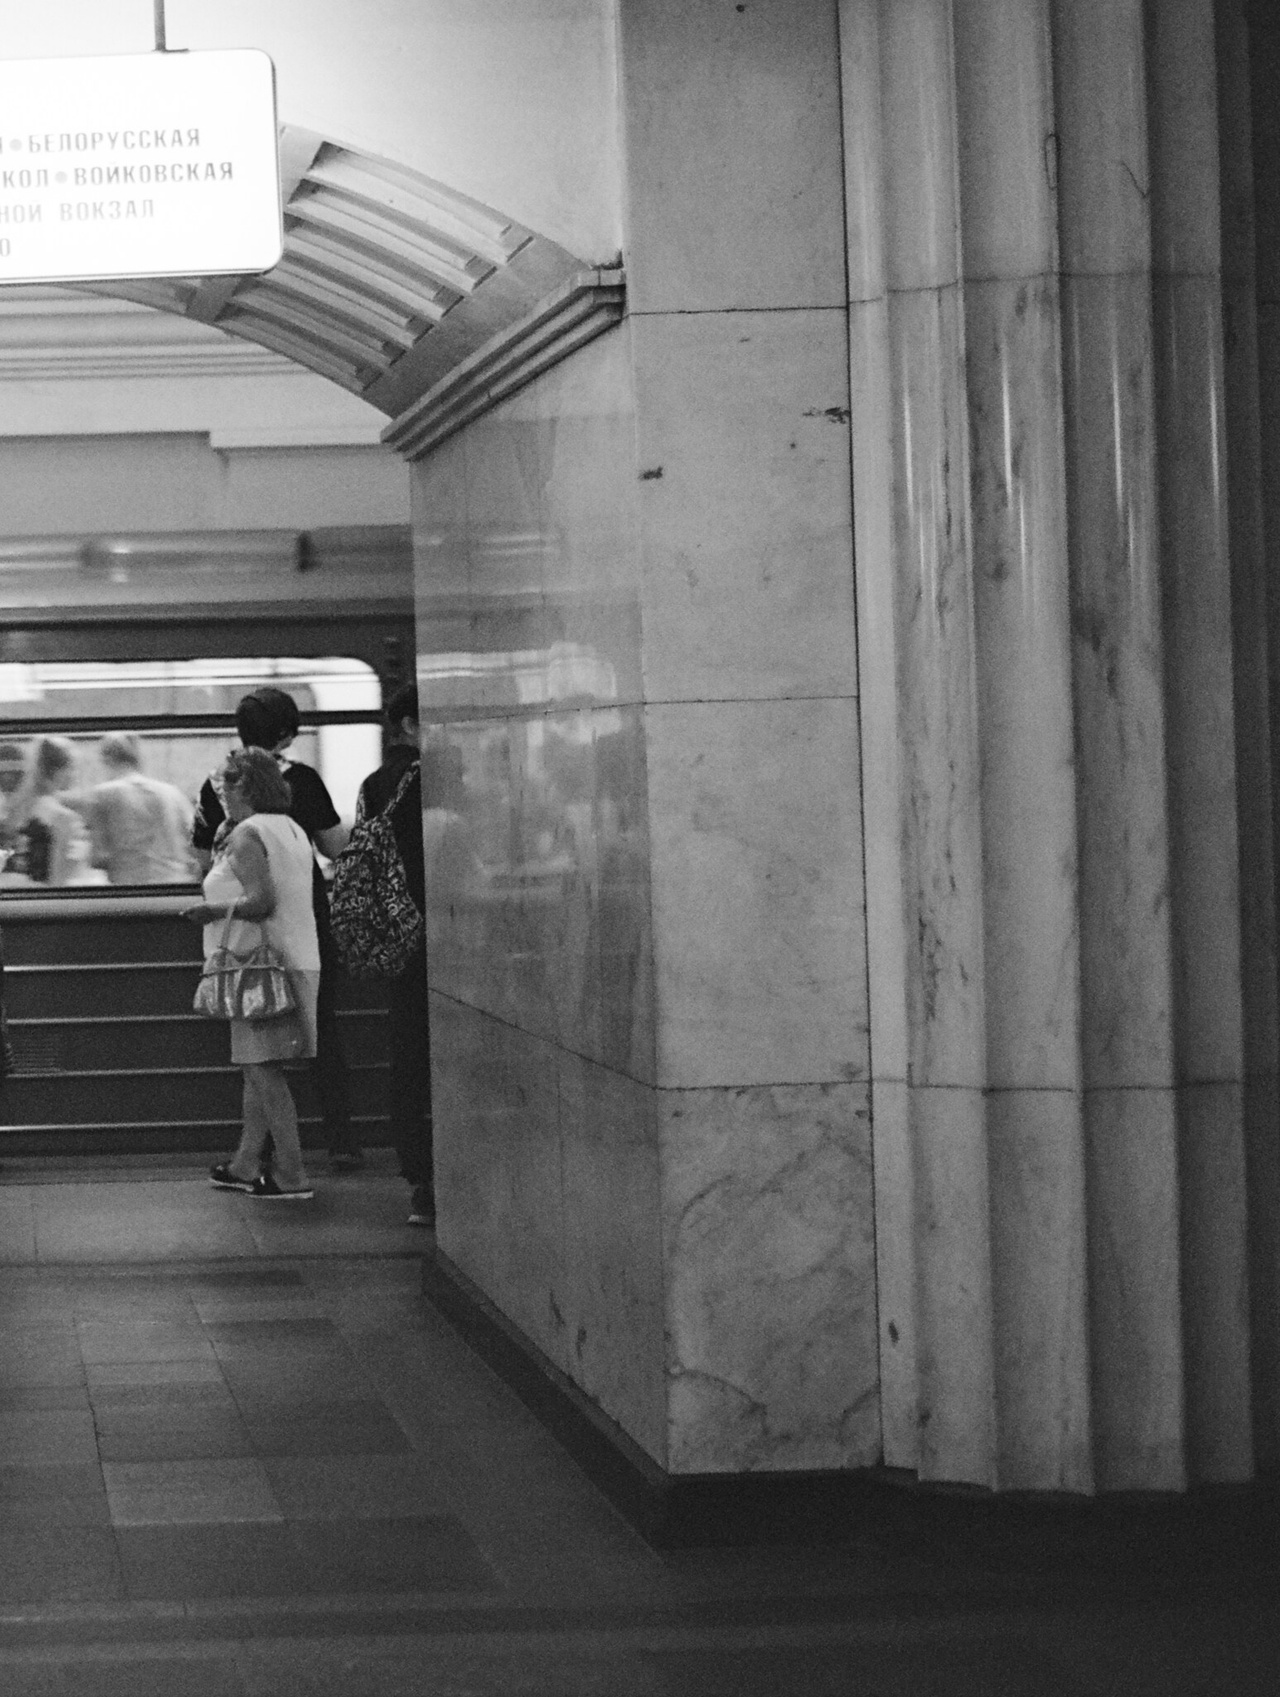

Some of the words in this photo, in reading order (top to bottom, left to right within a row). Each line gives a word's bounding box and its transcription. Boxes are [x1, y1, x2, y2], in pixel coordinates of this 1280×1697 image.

[28, 128, 201, 154] БЕЛОРУССКАЯ
[74, 161, 234, 187] ВОЙКОВСКАЯ
[59, 198, 155, 222] ВОКЗАЛ
